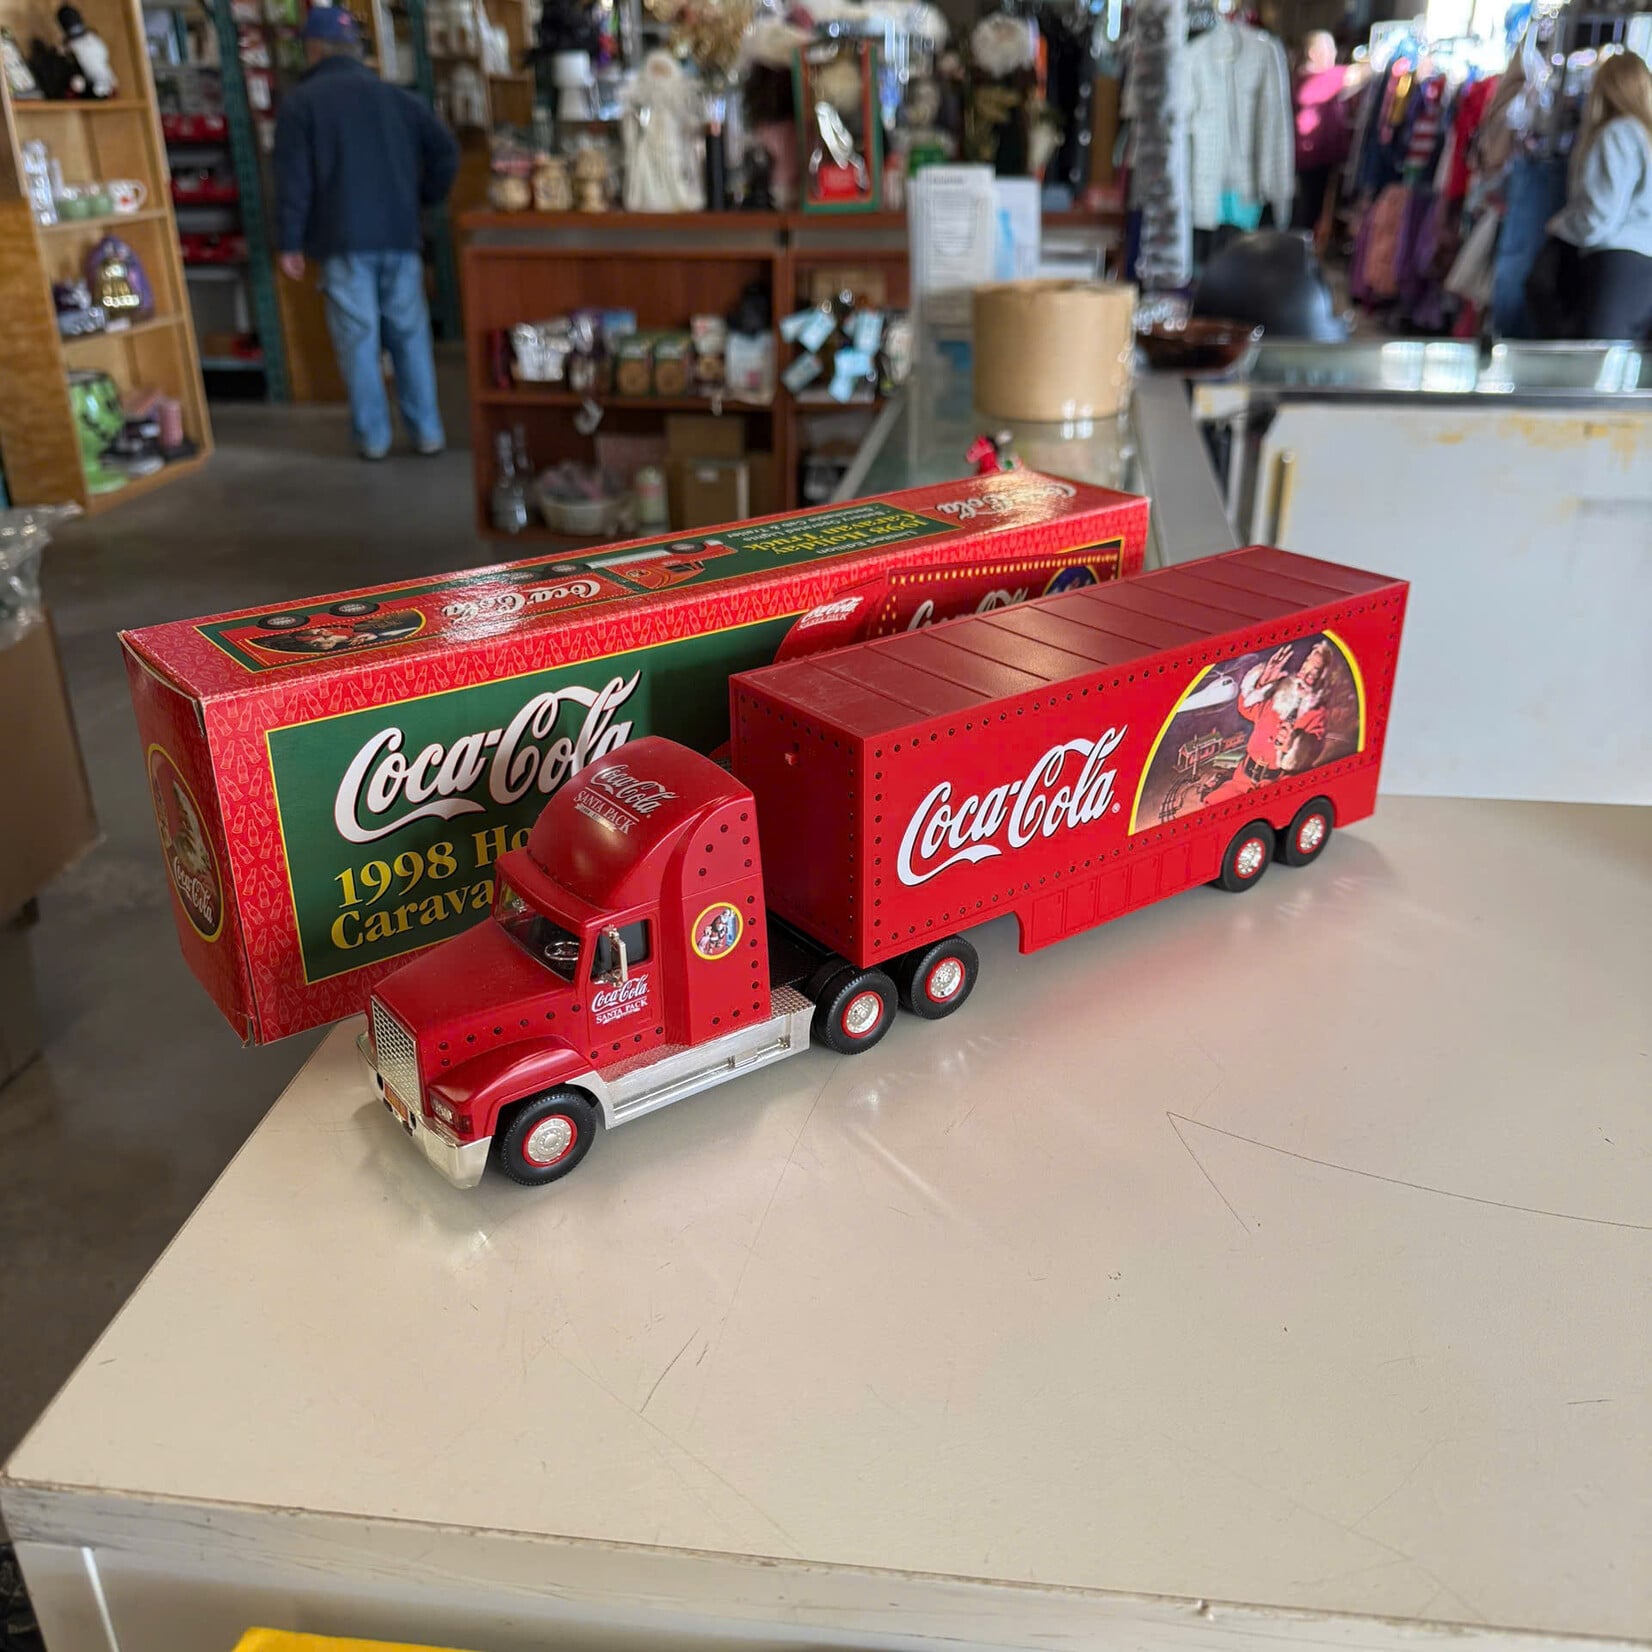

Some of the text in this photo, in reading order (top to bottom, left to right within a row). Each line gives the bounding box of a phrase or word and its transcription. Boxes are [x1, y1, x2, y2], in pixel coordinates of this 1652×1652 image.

[742, 513, 916, 551] Caravan Truck
[771, 519, 928, 555] 1998 Holiday
[442, 579, 601, 625] Coca-Cola
[573, 790, 607, 814] SANTA
[603, 806, 637, 835] PACK
[590, 764, 681, 815] Coca-Cola
[895, 724, 1128, 886] Coca-Cola
[173, 856, 215, 924] Coca-Cola
[334, 842, 457, 909] 1998
[330, 879, 494, 950] Carava
[591, 974, 649, 1013] Coca-Cola
[595, 999, 649, 1025] SANTA PACK
